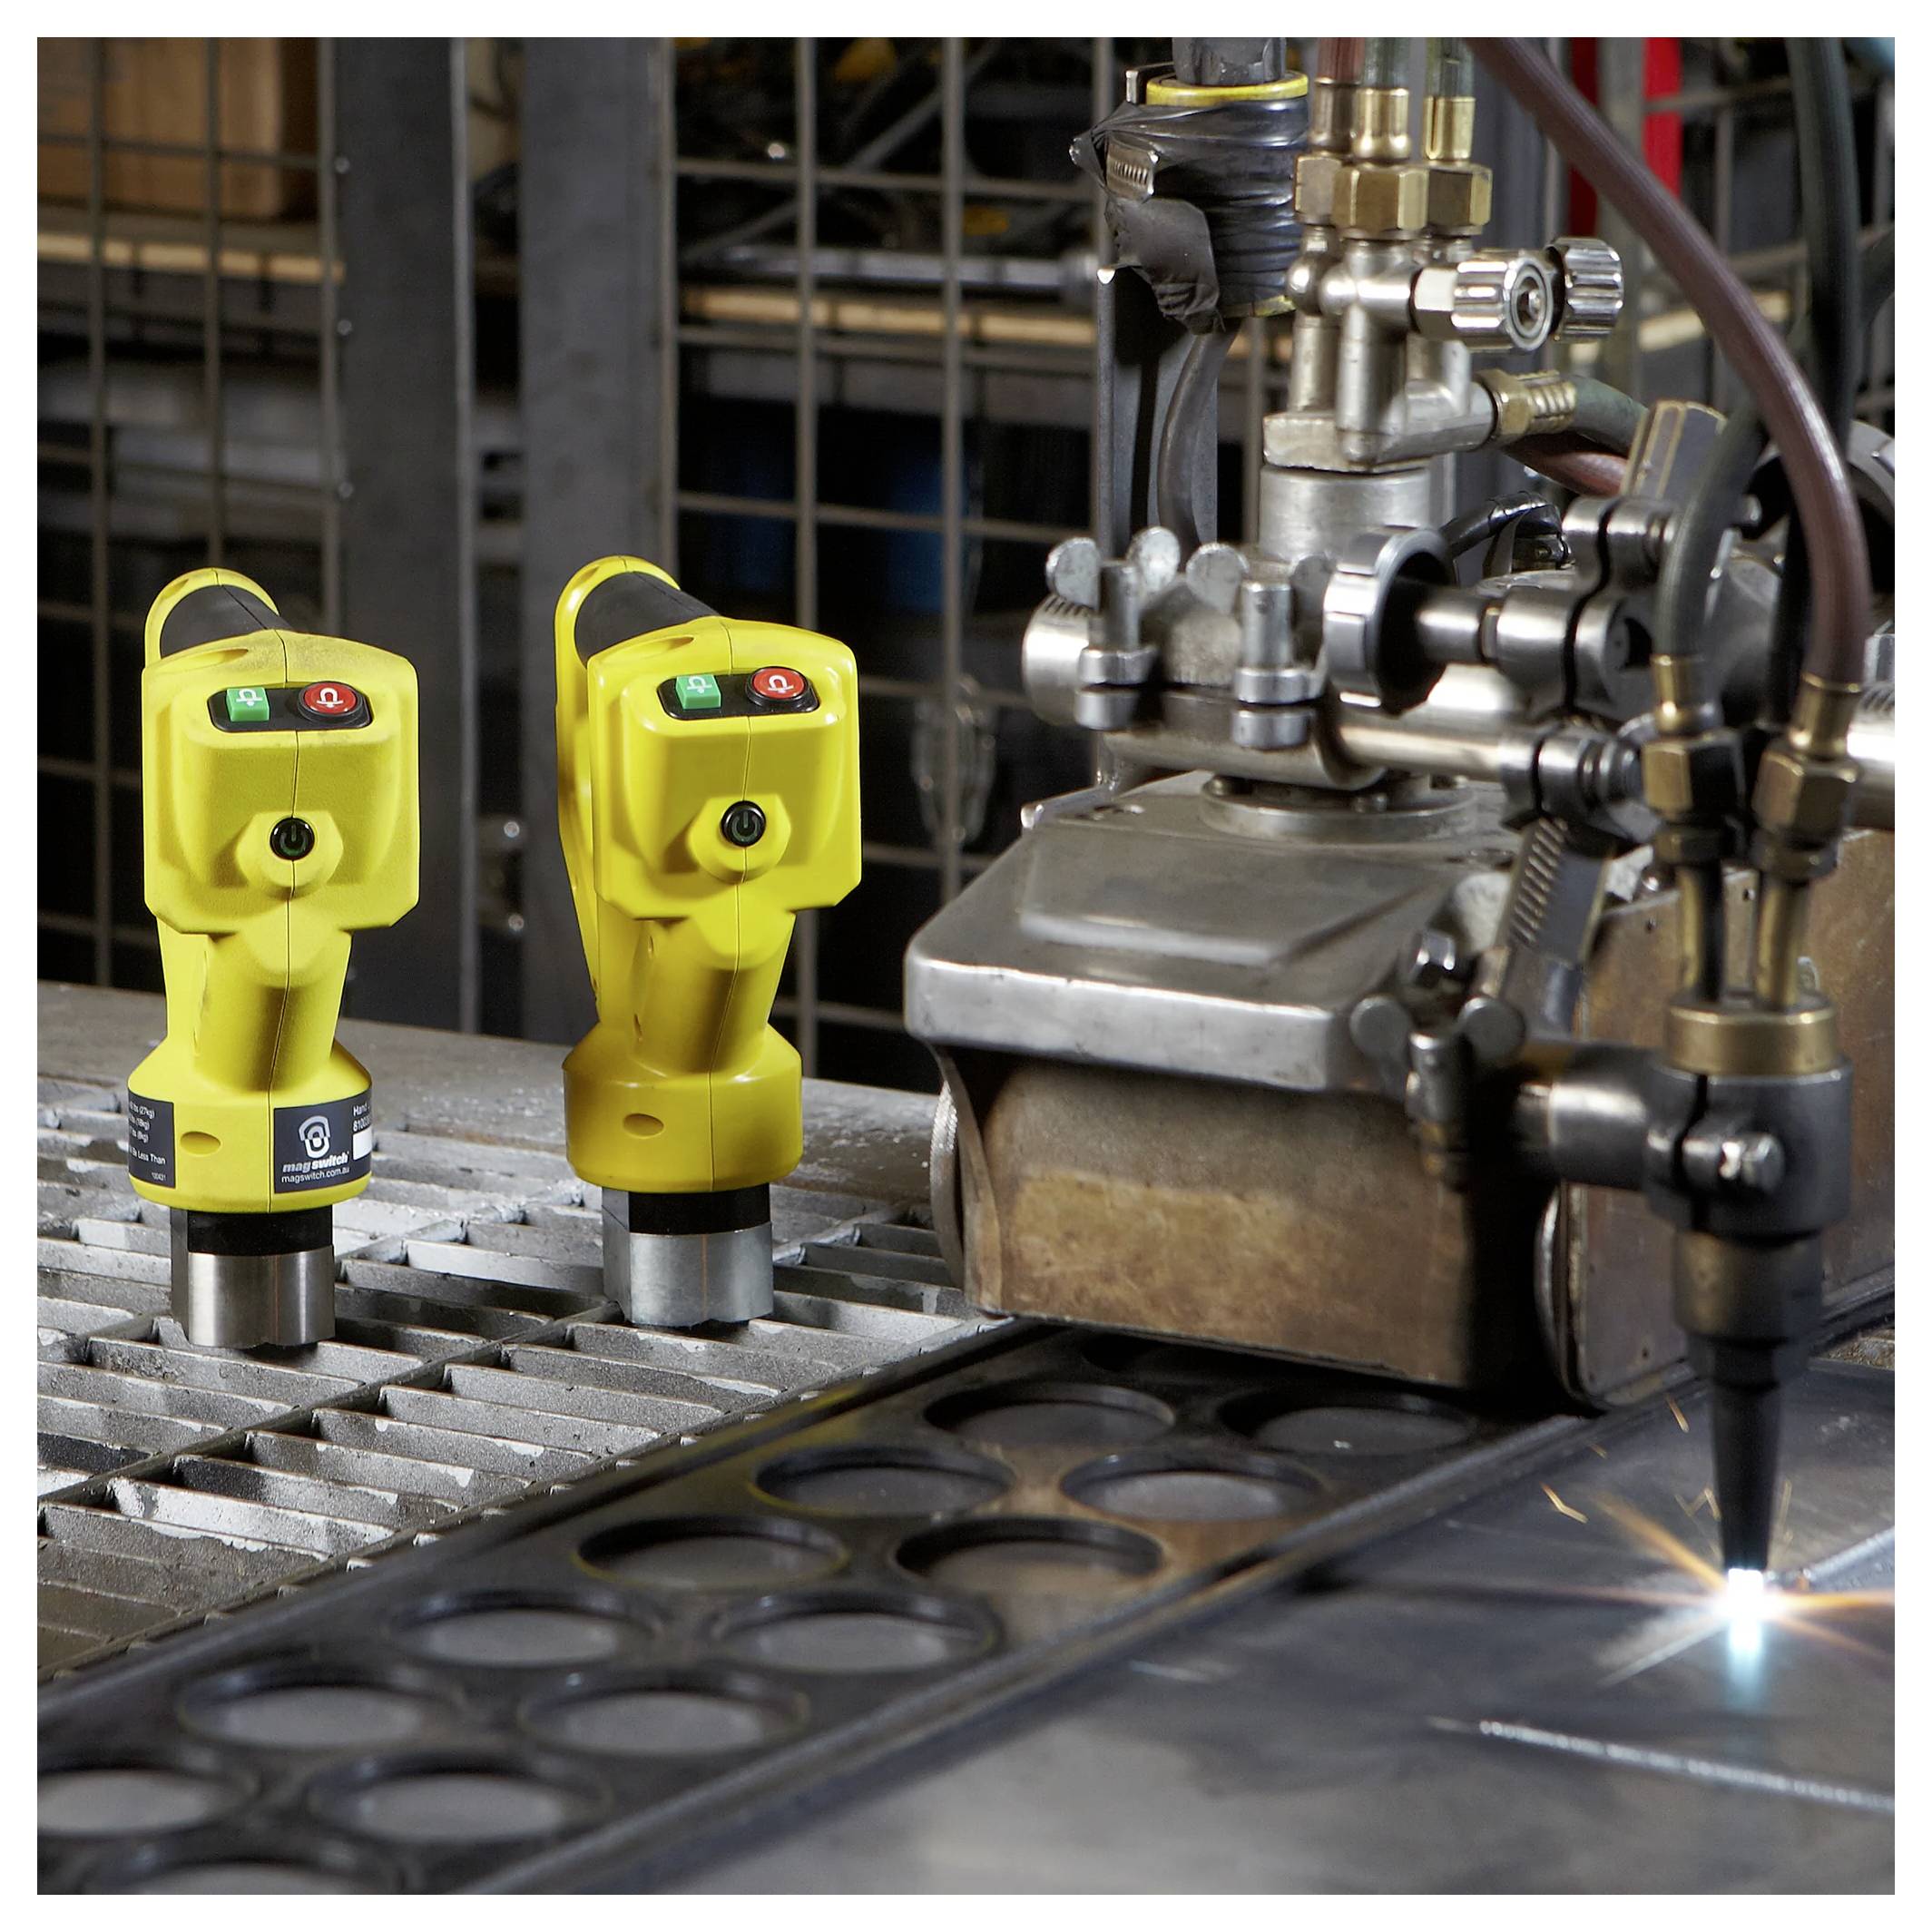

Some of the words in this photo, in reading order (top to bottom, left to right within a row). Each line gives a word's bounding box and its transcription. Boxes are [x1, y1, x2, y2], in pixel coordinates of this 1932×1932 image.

[138, 1151, 149, 1162] Less
[150, 1153, 166, 1165] Than
[281, 1167, 350, 1183] magswitch.com.au
